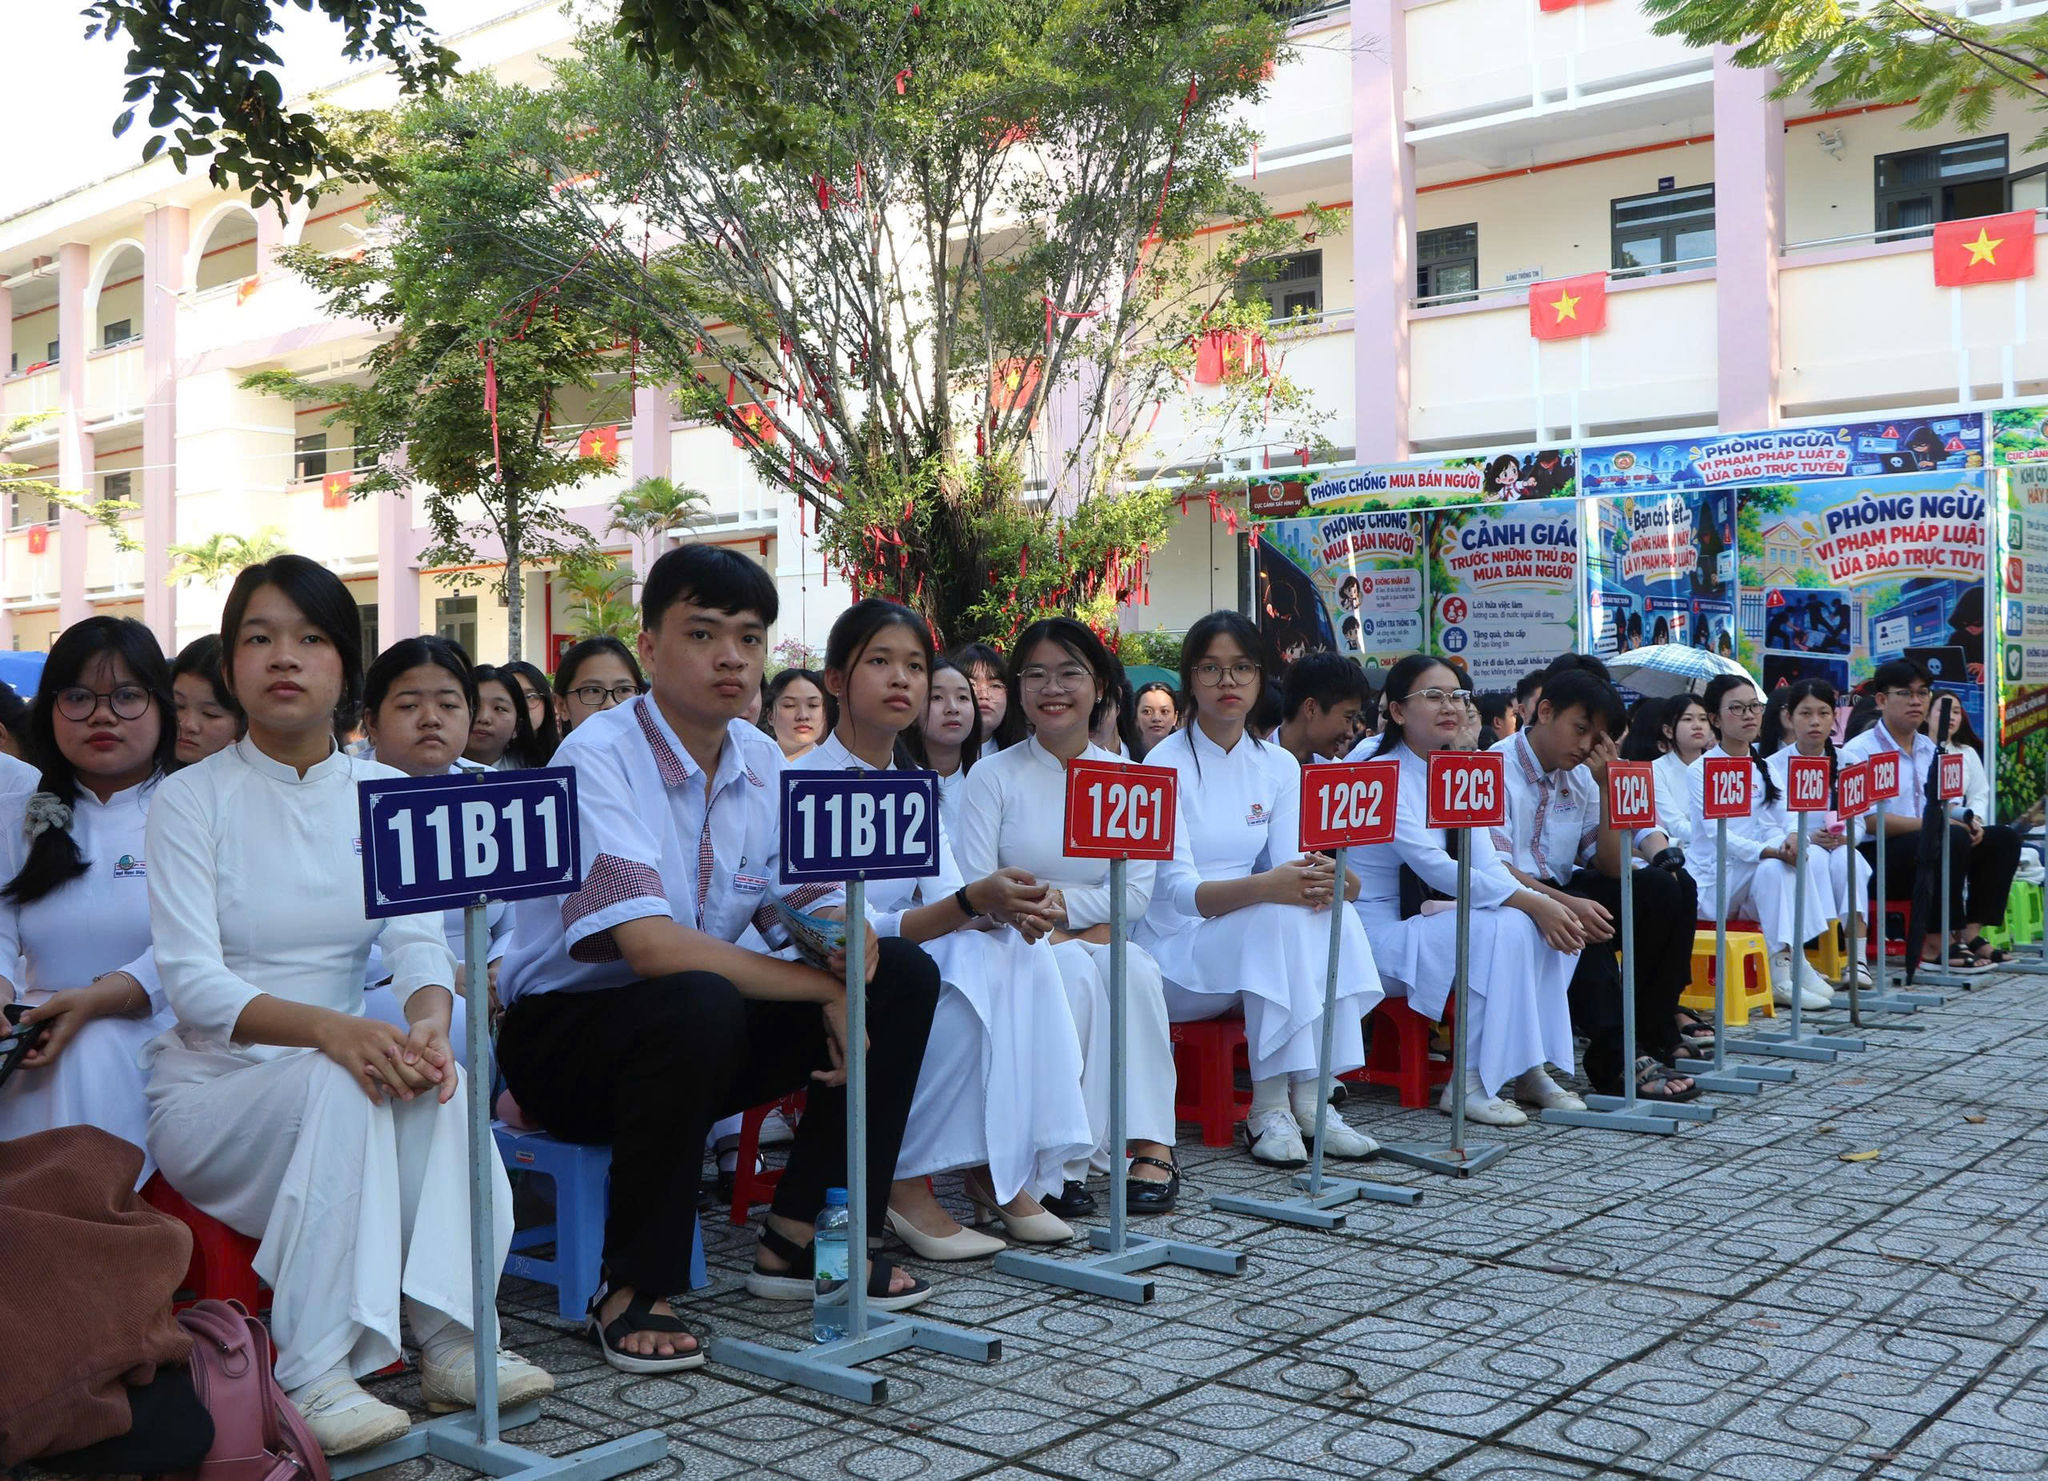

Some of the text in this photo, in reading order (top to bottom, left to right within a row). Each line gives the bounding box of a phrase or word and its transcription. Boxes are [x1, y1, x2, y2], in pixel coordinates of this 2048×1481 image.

[1518, 270, 1532, 280] THÔNG
[1698, 448, 1846, 472] VI PHẠM PHÁP LUẬT &
[1705, 432, 1834, 458] PHÒNG NGỪA
[1310, 469, 1481, 501] PHÒNG CHỐNG MUA BÁN NGƯỜI
[1705, 460, 1844, 483] LỪA ĐẢO TRỰC TUYẾN
[1634, 510, 1652, 533] Bạn
[1653, 506, 1664, 527] có
[1826, 496, 1914, 535] PHÒNG
[1323, 531, 1415, 564] MUA BÁN NGƯỜI
[1462, 519, 1526, 550] CẢNH
[1816, 542, 1834, 560] VI
[1837, 528, 1887, 554] PHẠM
[1890, 521, 1940, 544] PHÁP
[1450, 550, 1490, 571] TRƯỚC
[1492, 547, 1533, 563] NHỮNG
[1535, 546, 1558, 563] THỦ
[1474, 561, 1573, 582] MUA BÁN NGƯỜI
[1831, 556, 1863, 580] LỪA
[1866, 547, 1900, 570] ĐẢO
[1902, 548, 1946, 569] TRỰC
[1498, 600, 1510, 610] việc
[1512, 601, 1523, 609] làm
[1442, 768, 1494, 812] 12C3
[1712, 770, 1745, 805] 12C5
[1796, 768, 1824, 800] 12C6
[1844, 774, 1864, 808] 12C7
[1874, 762, 1895, 791] 12C8
[1944, 764, 1961, 790] 12C9
[1088, 782, 1163, 840] 12C1
[1318, 780, 1384, 832] 12C2
[1614, 775, 1648, 816] 12C4
[388, 796, 560, 886] 11B11
[796, 792, 926, 859] 11B12
